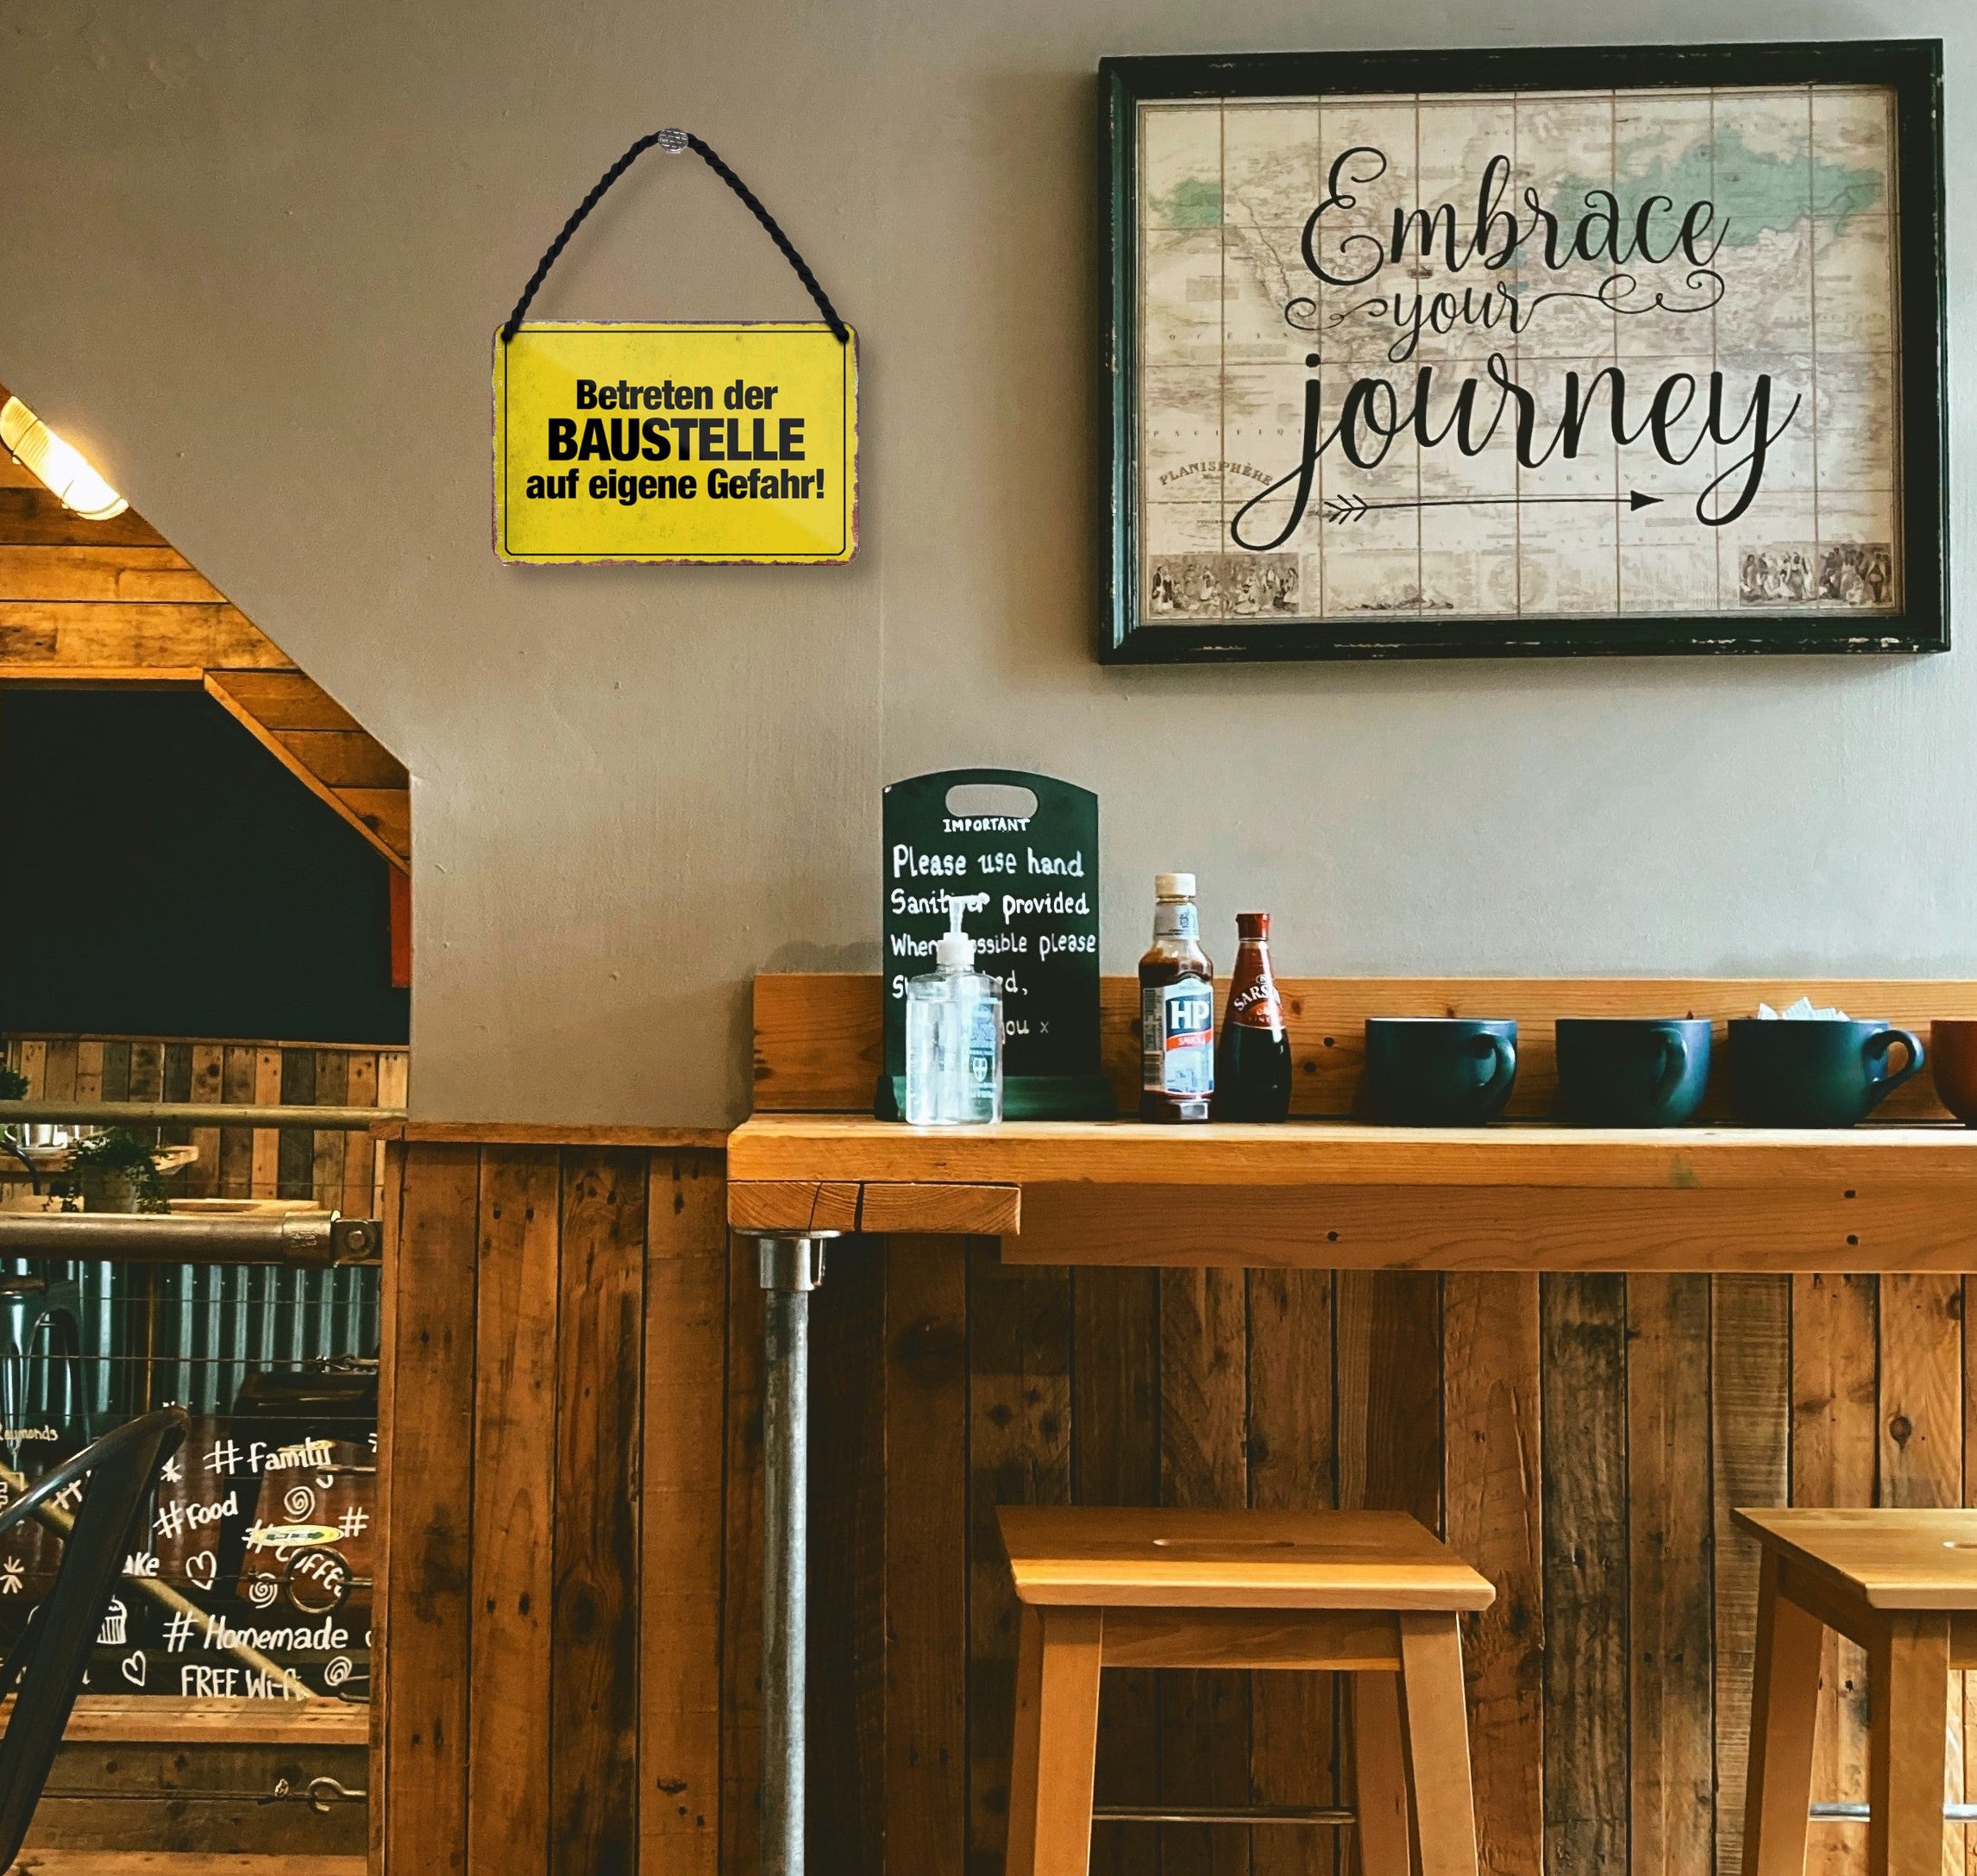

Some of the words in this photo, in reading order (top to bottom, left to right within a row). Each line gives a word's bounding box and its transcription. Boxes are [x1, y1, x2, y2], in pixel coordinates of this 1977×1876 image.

[1301, 147, 1729, 286] Embrace
[1388, 281, 1535, 362] your
[576, 379, 713, 410] Betreten
[724, 379, 778, 410] der
[548, 417, 806, 461] BAUSTELLE
[1230, 353, 1801, 551] journey
[525, 468, 580, 499] auf
[588, 468, 697, 505] eigene
[707, 468, 825, 499] Gefahr!
[1159, 461, 1274, 486] PLANISPHÈRE
[942, 818, 1031, 833] IMPORTANT
[893, 844, 967, 878] Please
[977, 852, 1017, 875] use
[1027, 846, 1085, 878] hand
[1002, 890, 1090, 925] provided
[966, 932, 1028, 955] ssible
[1039, 932, 1096, 962] please
[1171, 1001, 1210, 1029] HP
[181, 1666, 239, 1698] FREE
